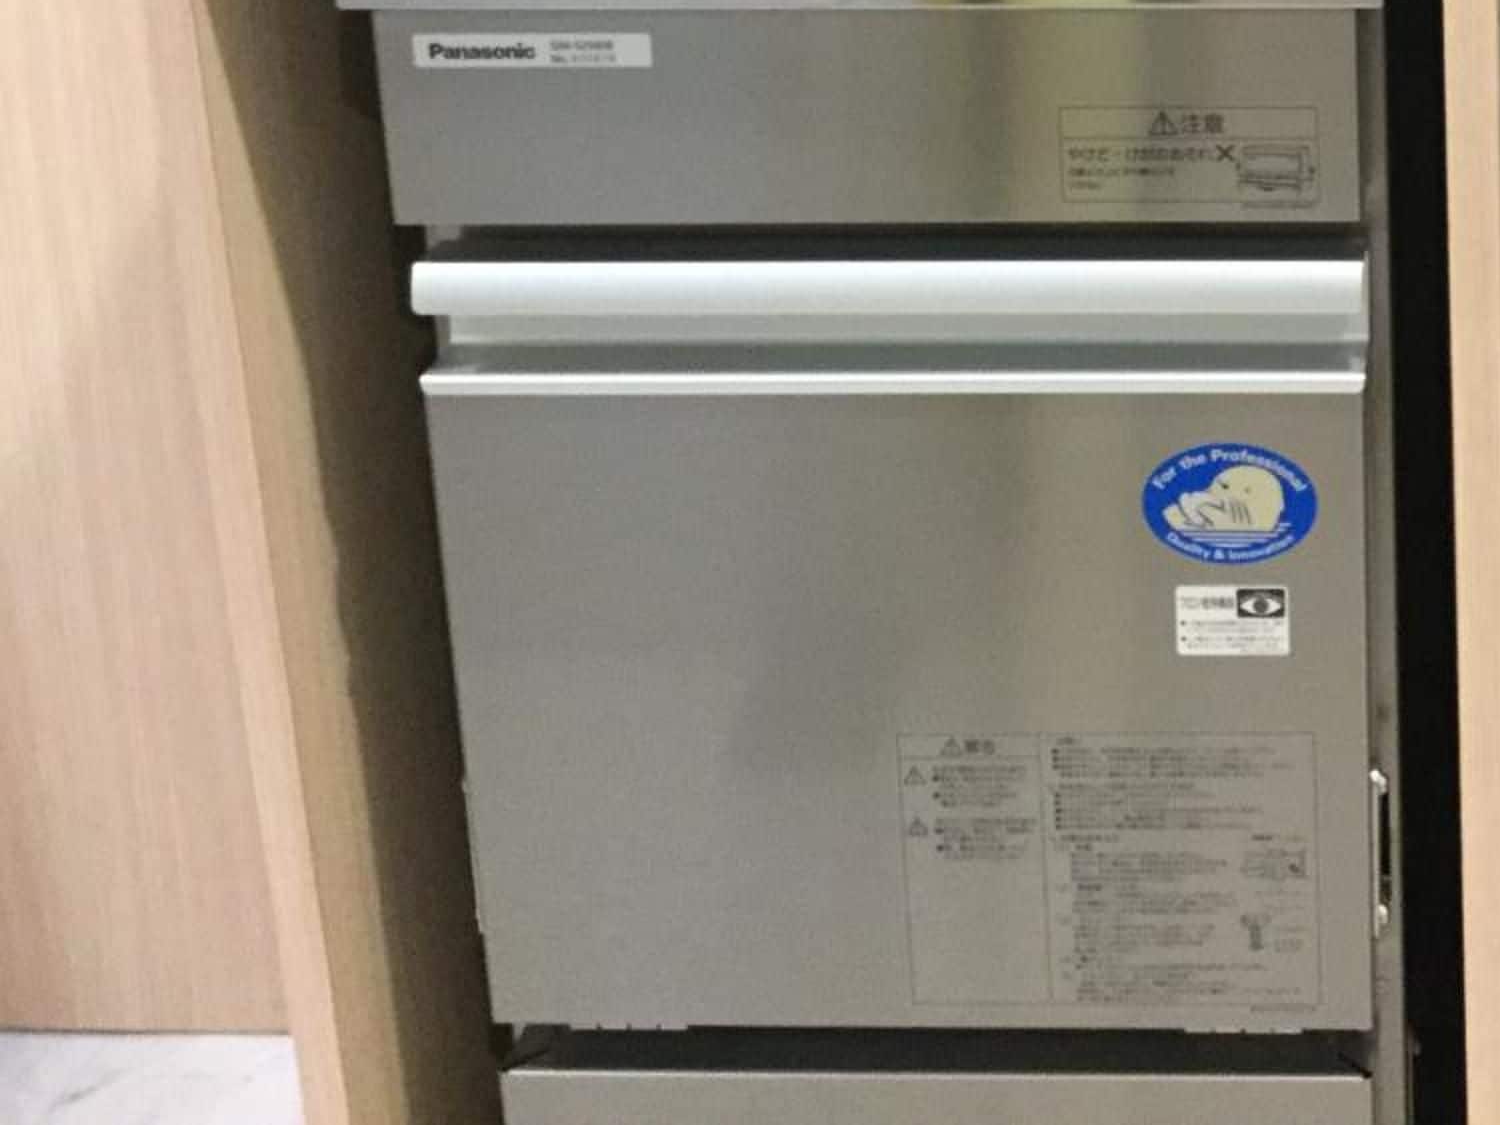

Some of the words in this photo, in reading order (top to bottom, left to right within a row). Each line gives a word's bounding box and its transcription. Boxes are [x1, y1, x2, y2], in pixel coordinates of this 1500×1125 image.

[428, 42, 536, 60] Panasonic
[1152, 467, 1177, 489] For
[1179, 453, 1207, 469] the
[1210, 448, 1307, 491] Professional
